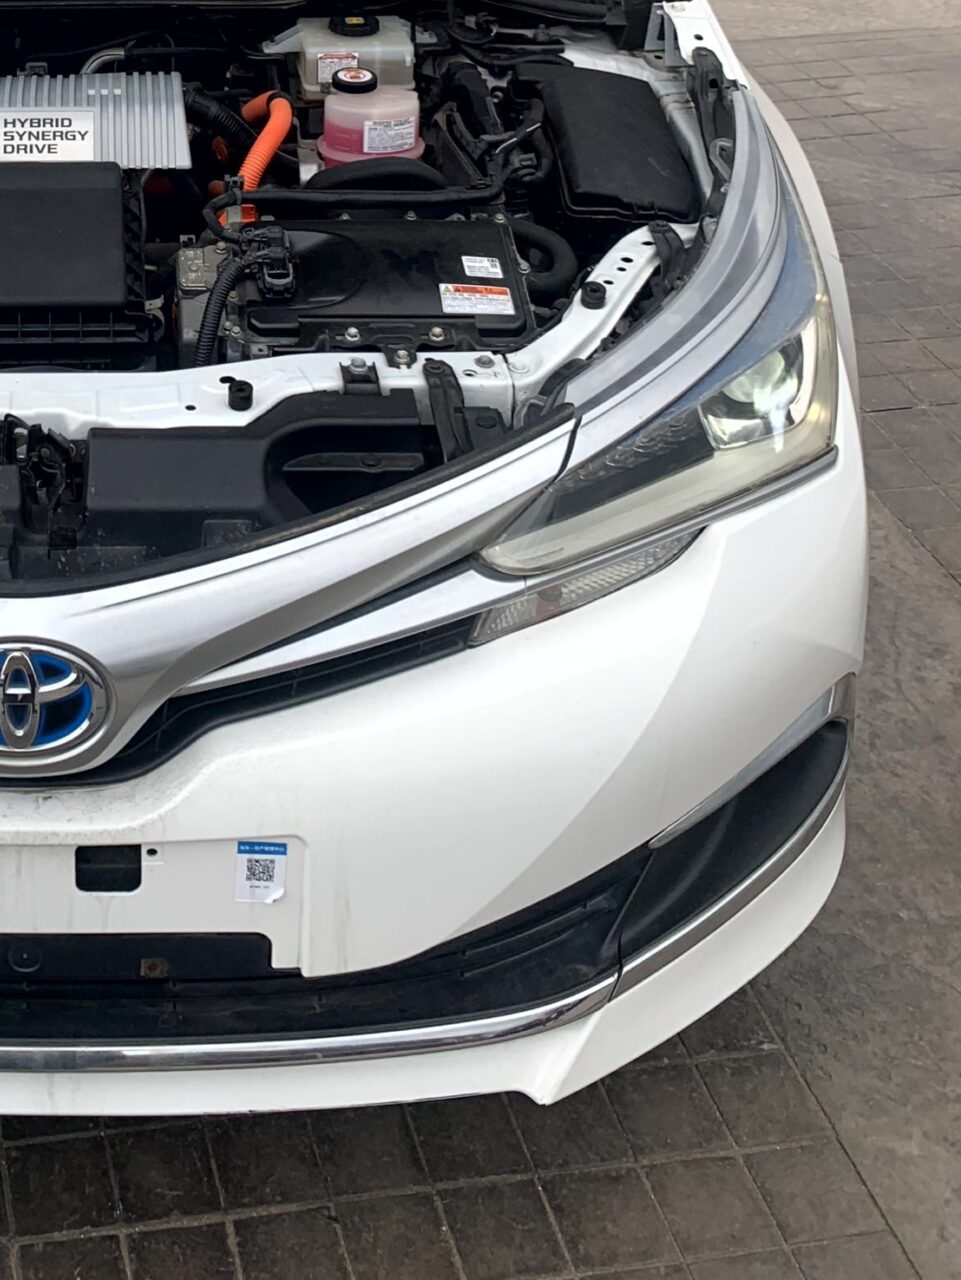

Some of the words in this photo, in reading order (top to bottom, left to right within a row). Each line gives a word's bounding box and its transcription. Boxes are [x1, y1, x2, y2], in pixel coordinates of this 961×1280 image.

[4, 118, 72, 128] HYBRID
[3, 130, 89, 141] SYNERGY
[3, 144, 58, 154] DRIVE
